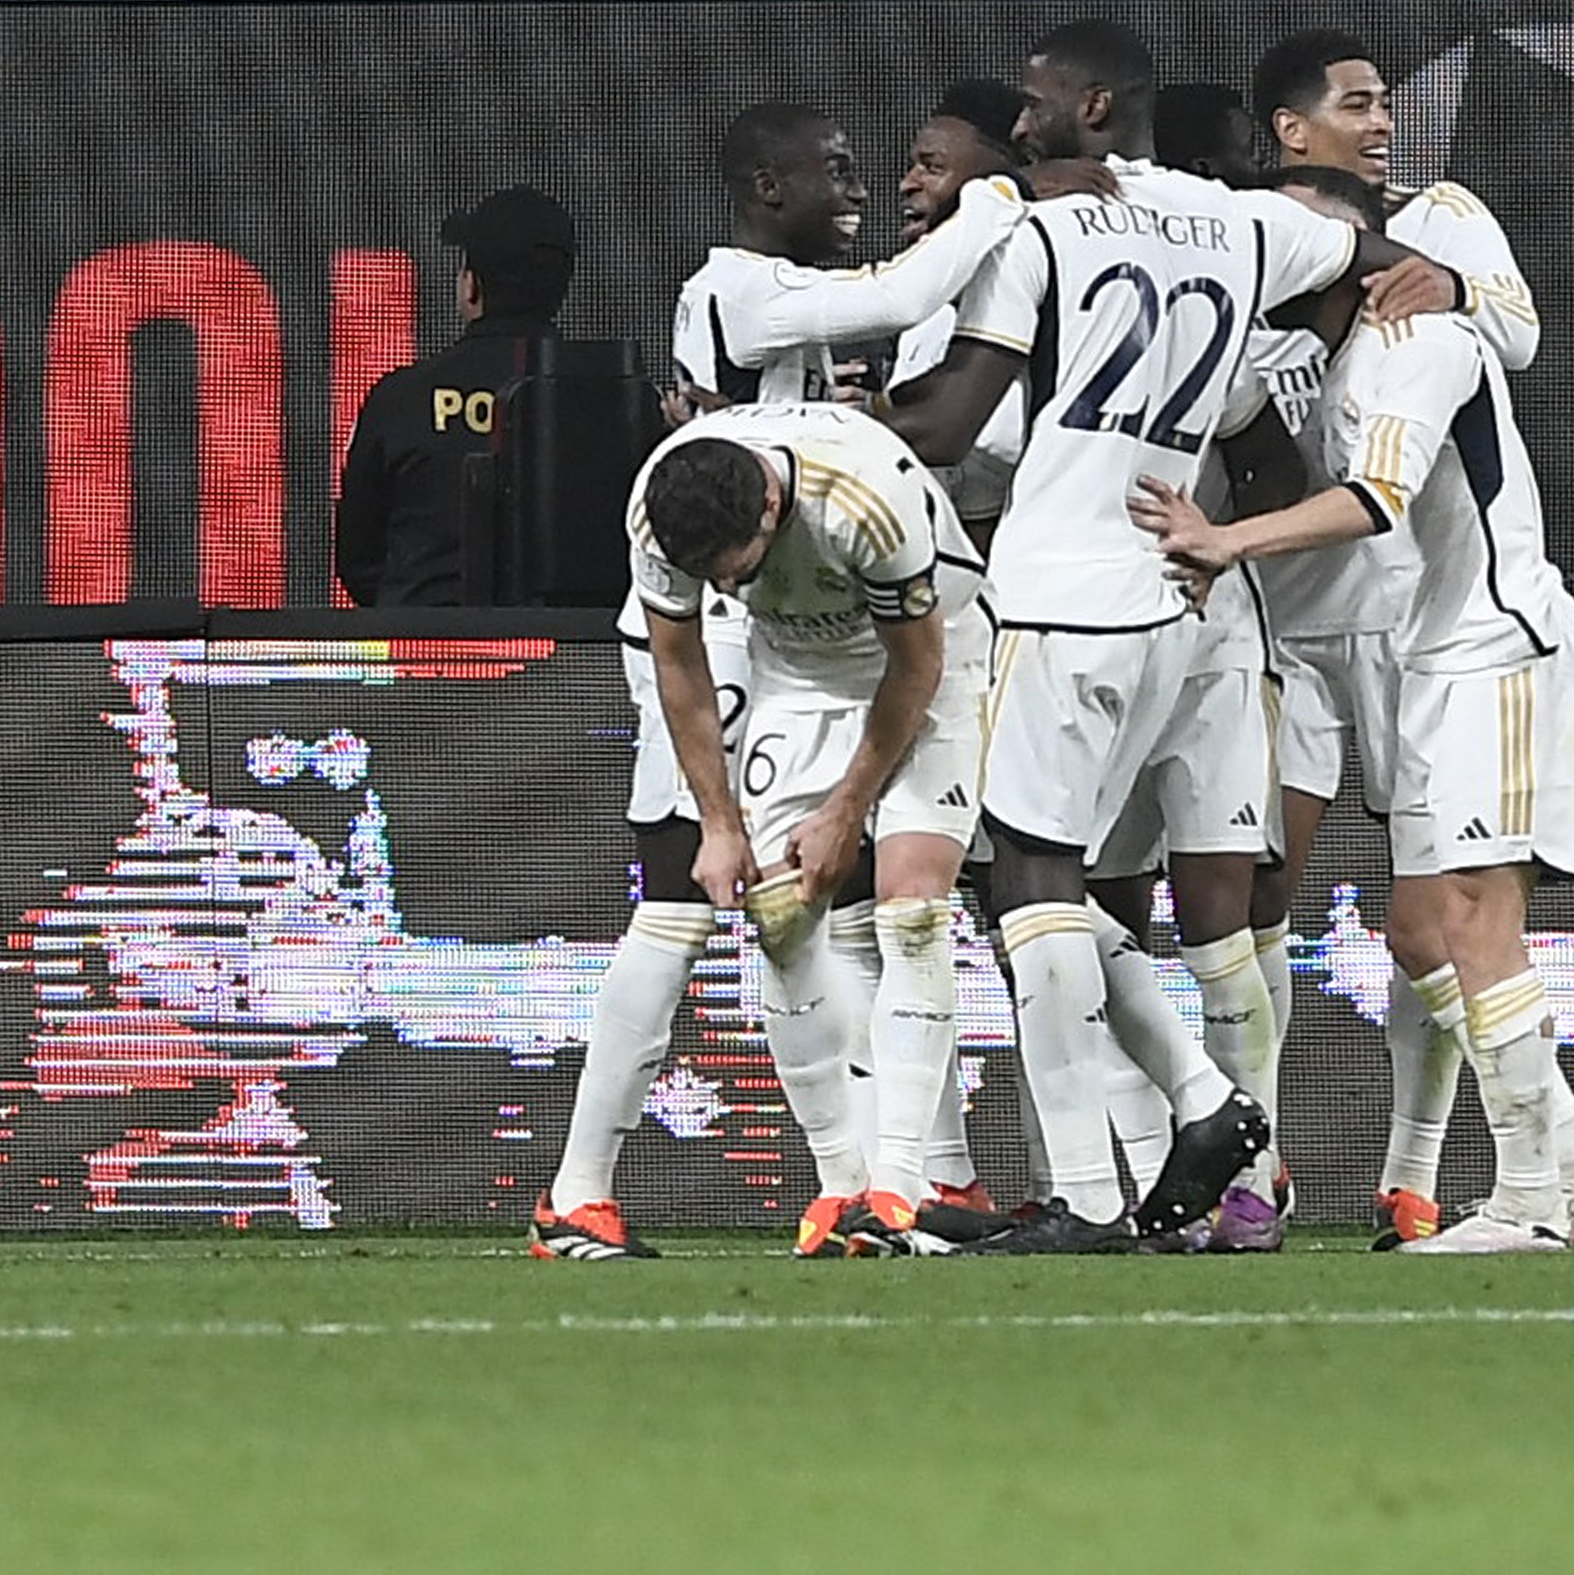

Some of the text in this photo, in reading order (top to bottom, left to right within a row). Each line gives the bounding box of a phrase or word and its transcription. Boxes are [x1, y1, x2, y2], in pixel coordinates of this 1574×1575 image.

[1058, 261, 1235, 456] 22
[716, 682, 748, 755] 2
[744, 732, 787, 798] 6
